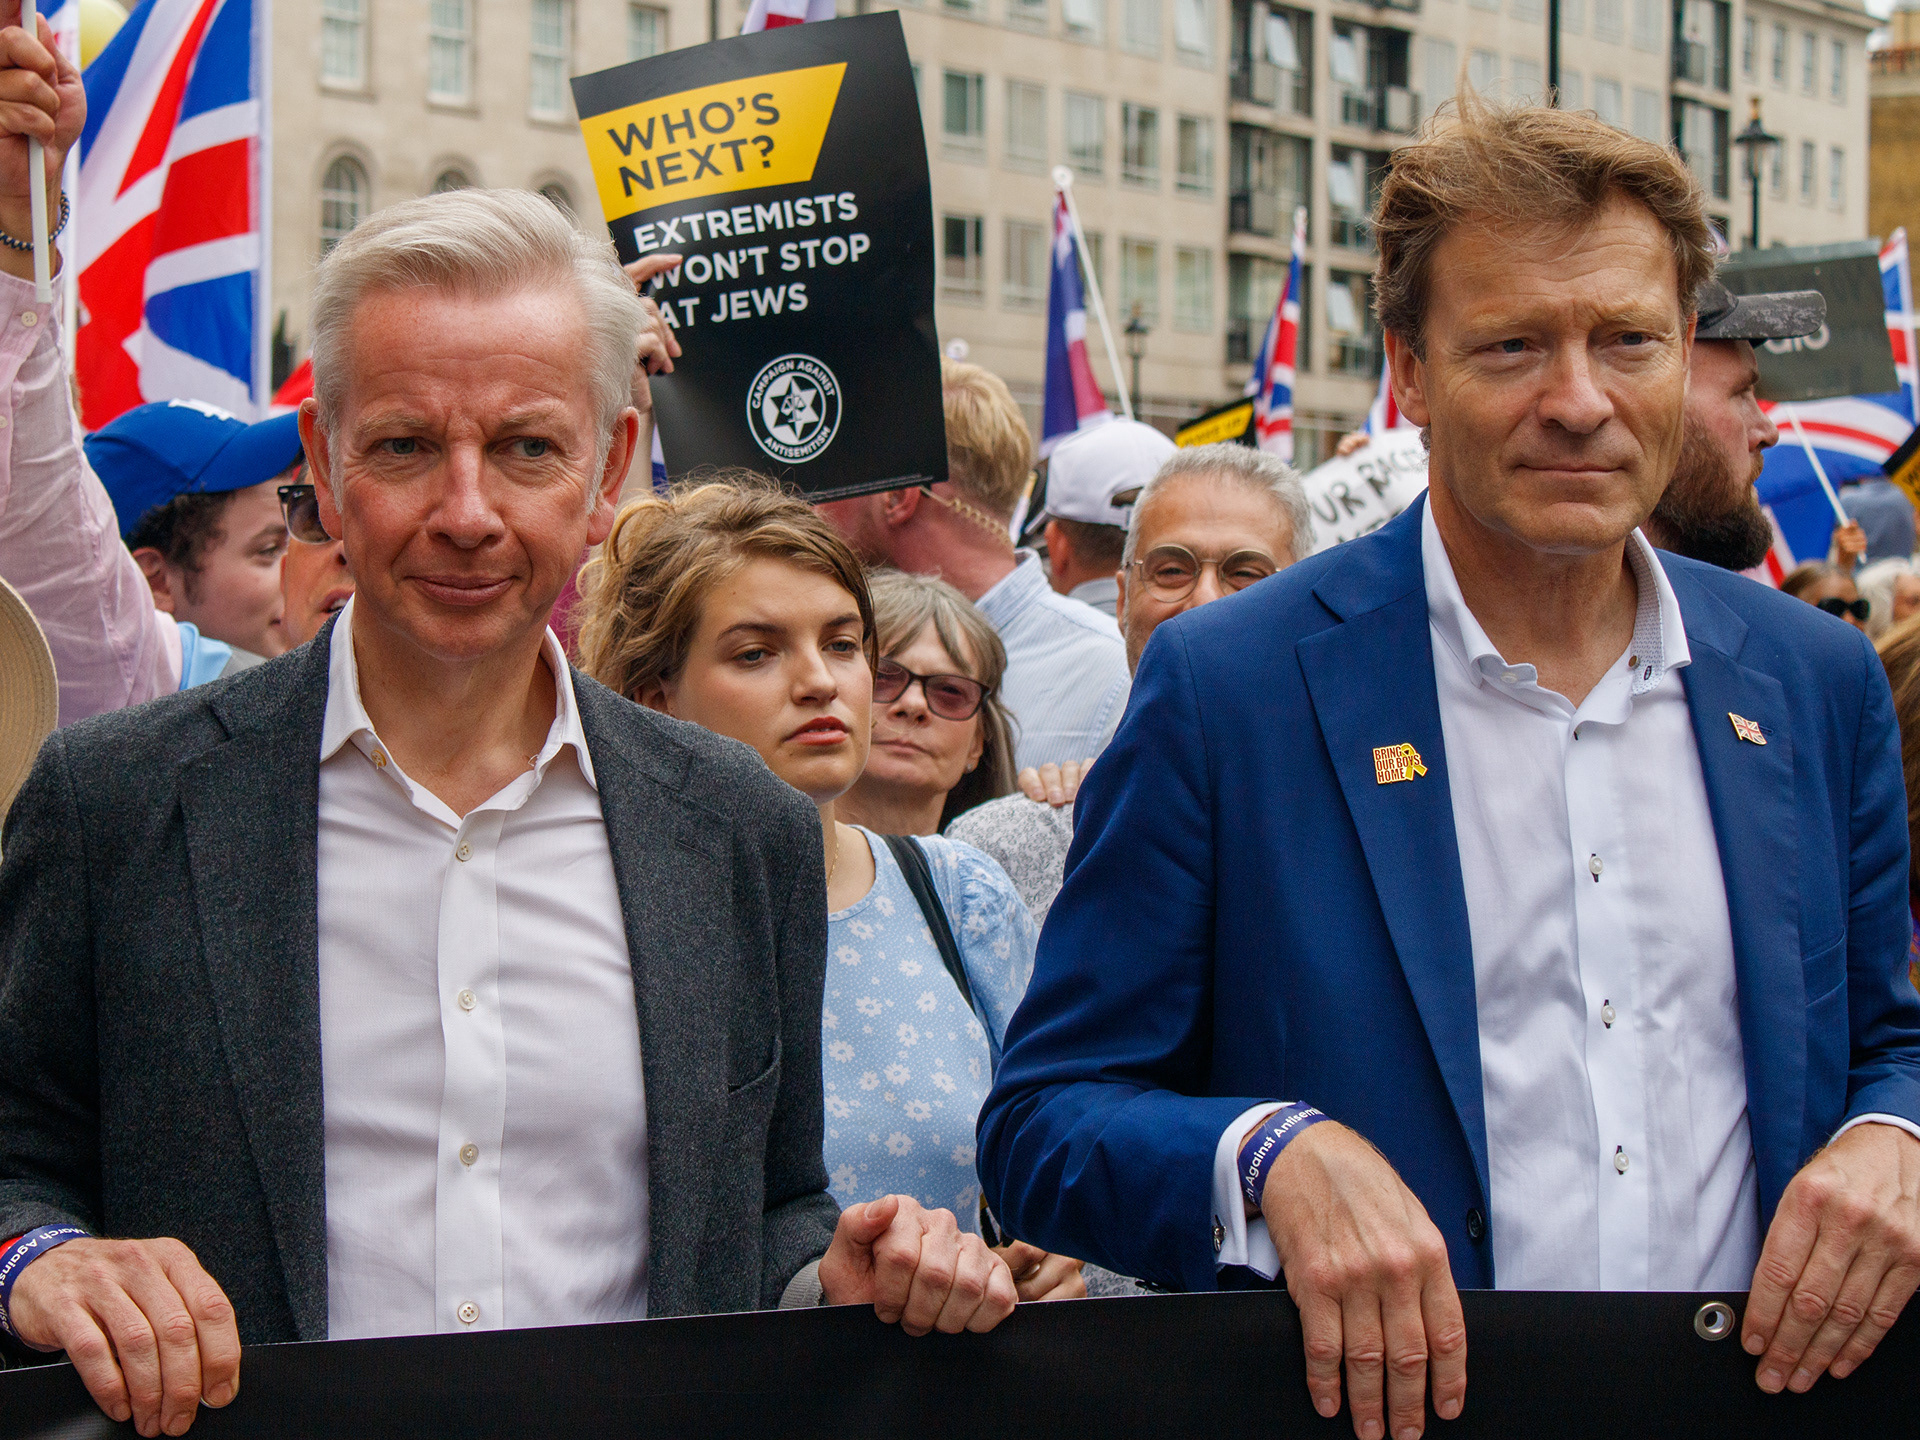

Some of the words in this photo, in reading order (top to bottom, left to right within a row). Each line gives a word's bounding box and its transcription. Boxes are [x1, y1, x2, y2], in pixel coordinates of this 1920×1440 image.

[606, 93, 780, 157] WHO'S
[618, 135, 775, 197] NEXT?
[633, 192, 859, 253] EXTREMISTS
[780, 233, 870, 272] STOP
[659, 297, 700, 329] AT
[711, 283, 808, 323] JEWS
[752, 360, 795, 409] CAMPAIGN
[797, 360, 835, 396] AGAINST
[764, 426, 831, 457] ANTISEMITISM
[1374, 746, 1402, 760] BRING
[1376, 758, 1395, 771] OUR
[1395, 754, 1420, 768] BOYS
[1377, 767, 1405, 782] HOME
[1245, 1136, 1276, 1187] Against
